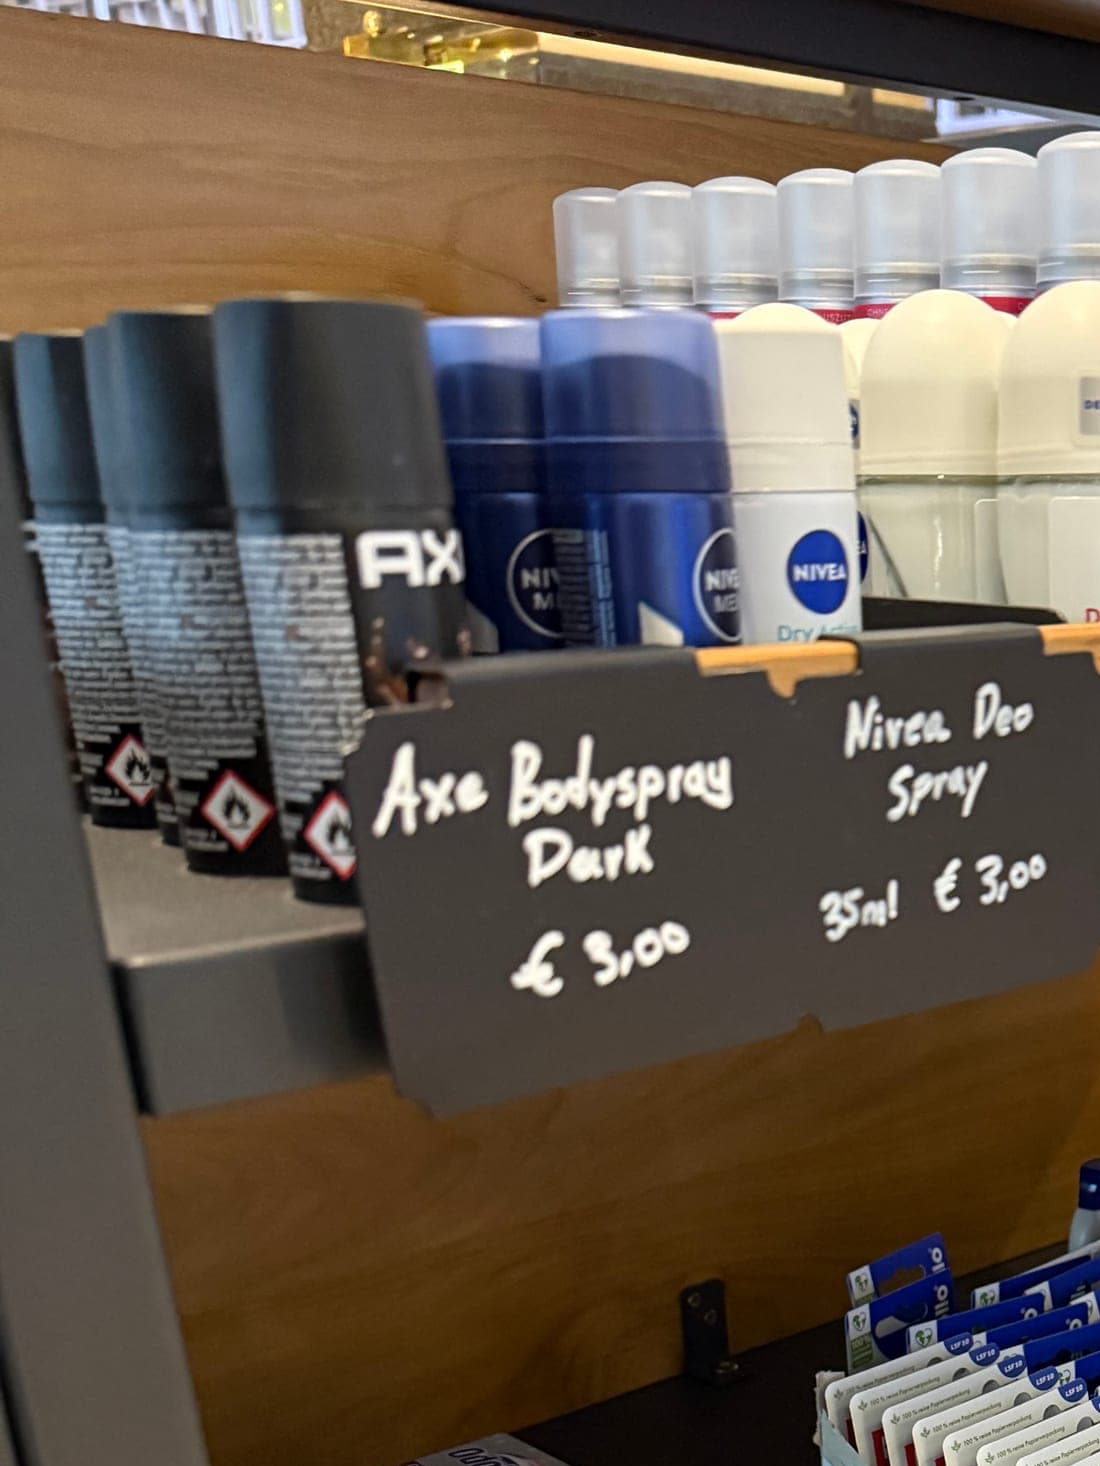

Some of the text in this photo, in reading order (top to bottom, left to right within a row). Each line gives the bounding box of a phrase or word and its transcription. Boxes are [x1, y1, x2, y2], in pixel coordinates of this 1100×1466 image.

[357, 530, 465, 590] AX
[793, 564, 847, 582] NIVEA
[844, 681, 1035, 760] Nivea Deo
[371, 733, 734, 839] Axe Bodyspray
[886, 760, 989, 823] Spray
[522, 823, 655, 889] Dark
[818, 853, 1047, 943] 35ml € 3,00
[510, 920, 690, 998] € 3,00
